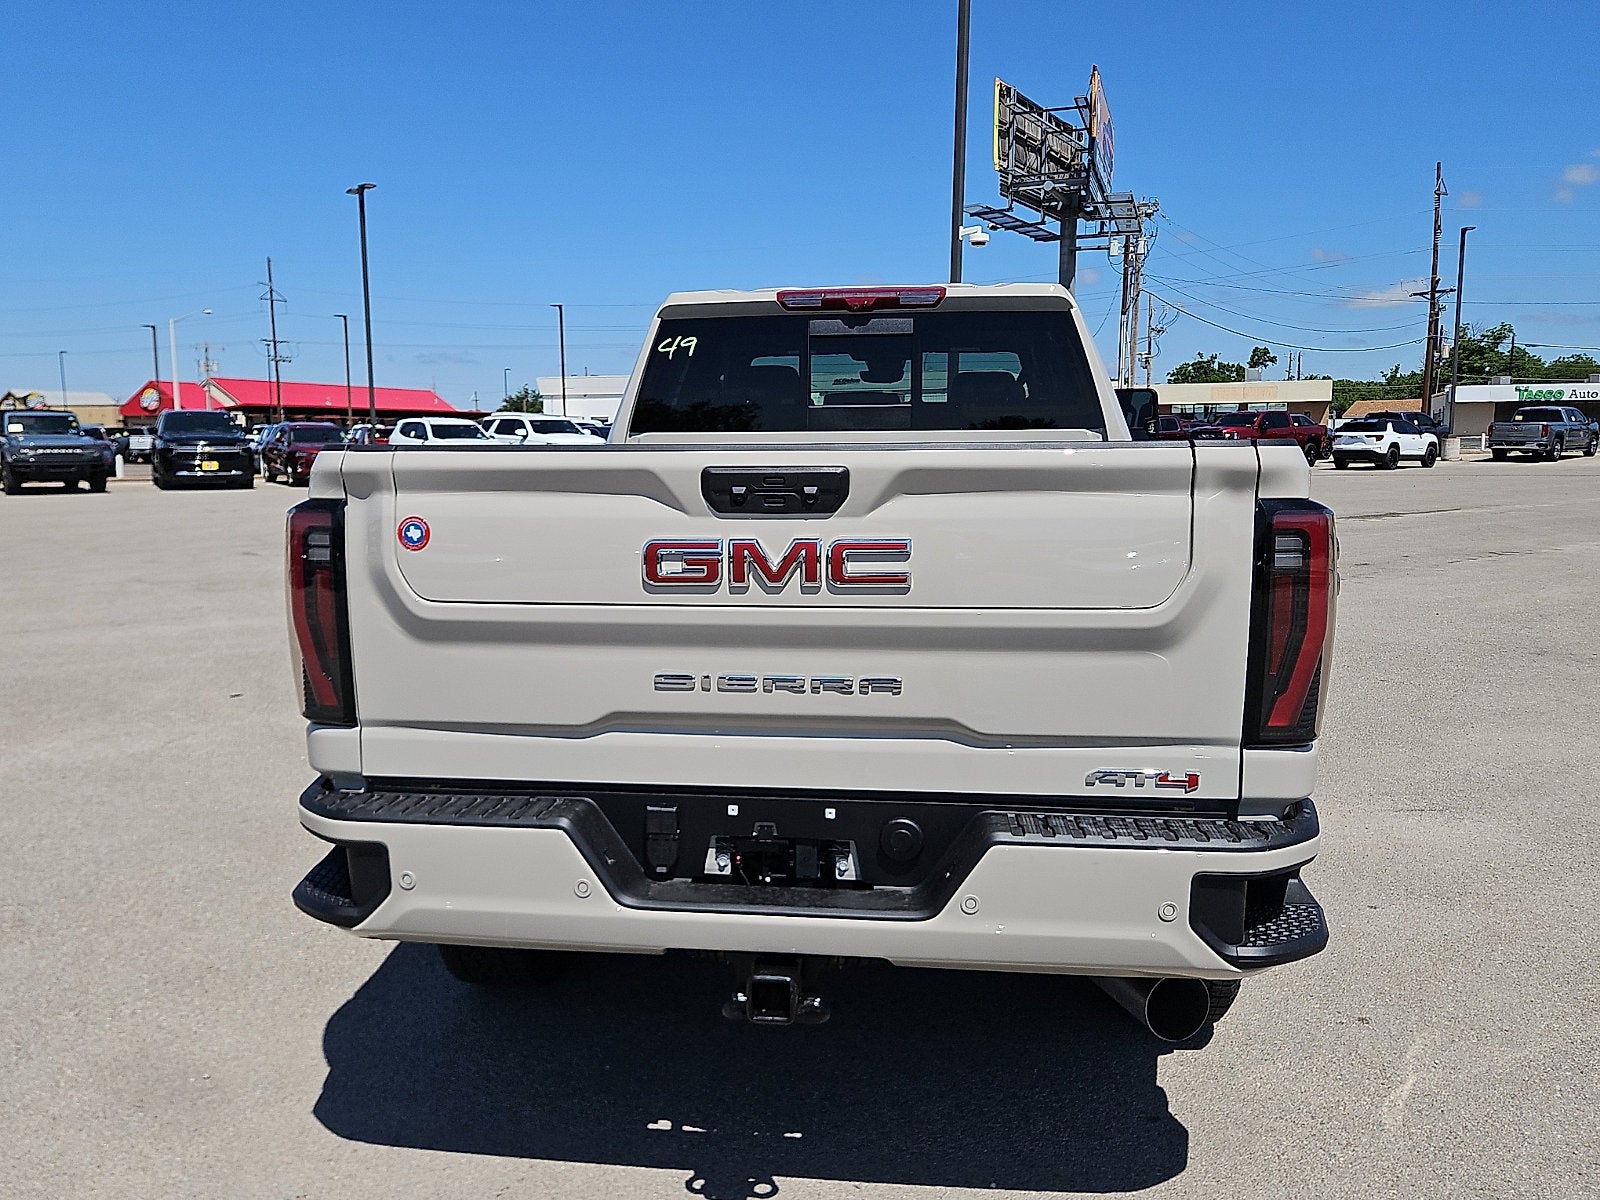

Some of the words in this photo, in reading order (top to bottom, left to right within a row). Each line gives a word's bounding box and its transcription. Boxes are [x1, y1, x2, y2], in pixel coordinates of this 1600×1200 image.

[657, 335, 698, 361] 49
[1514, 386, 1565, 400] TASCO
[1568, 389, 1599, 399] Auto
[641, 538, 913, 595] GMC
[653, 673, 903, 696] SIERRA
[1084, 768, 1201, 794] AT4
